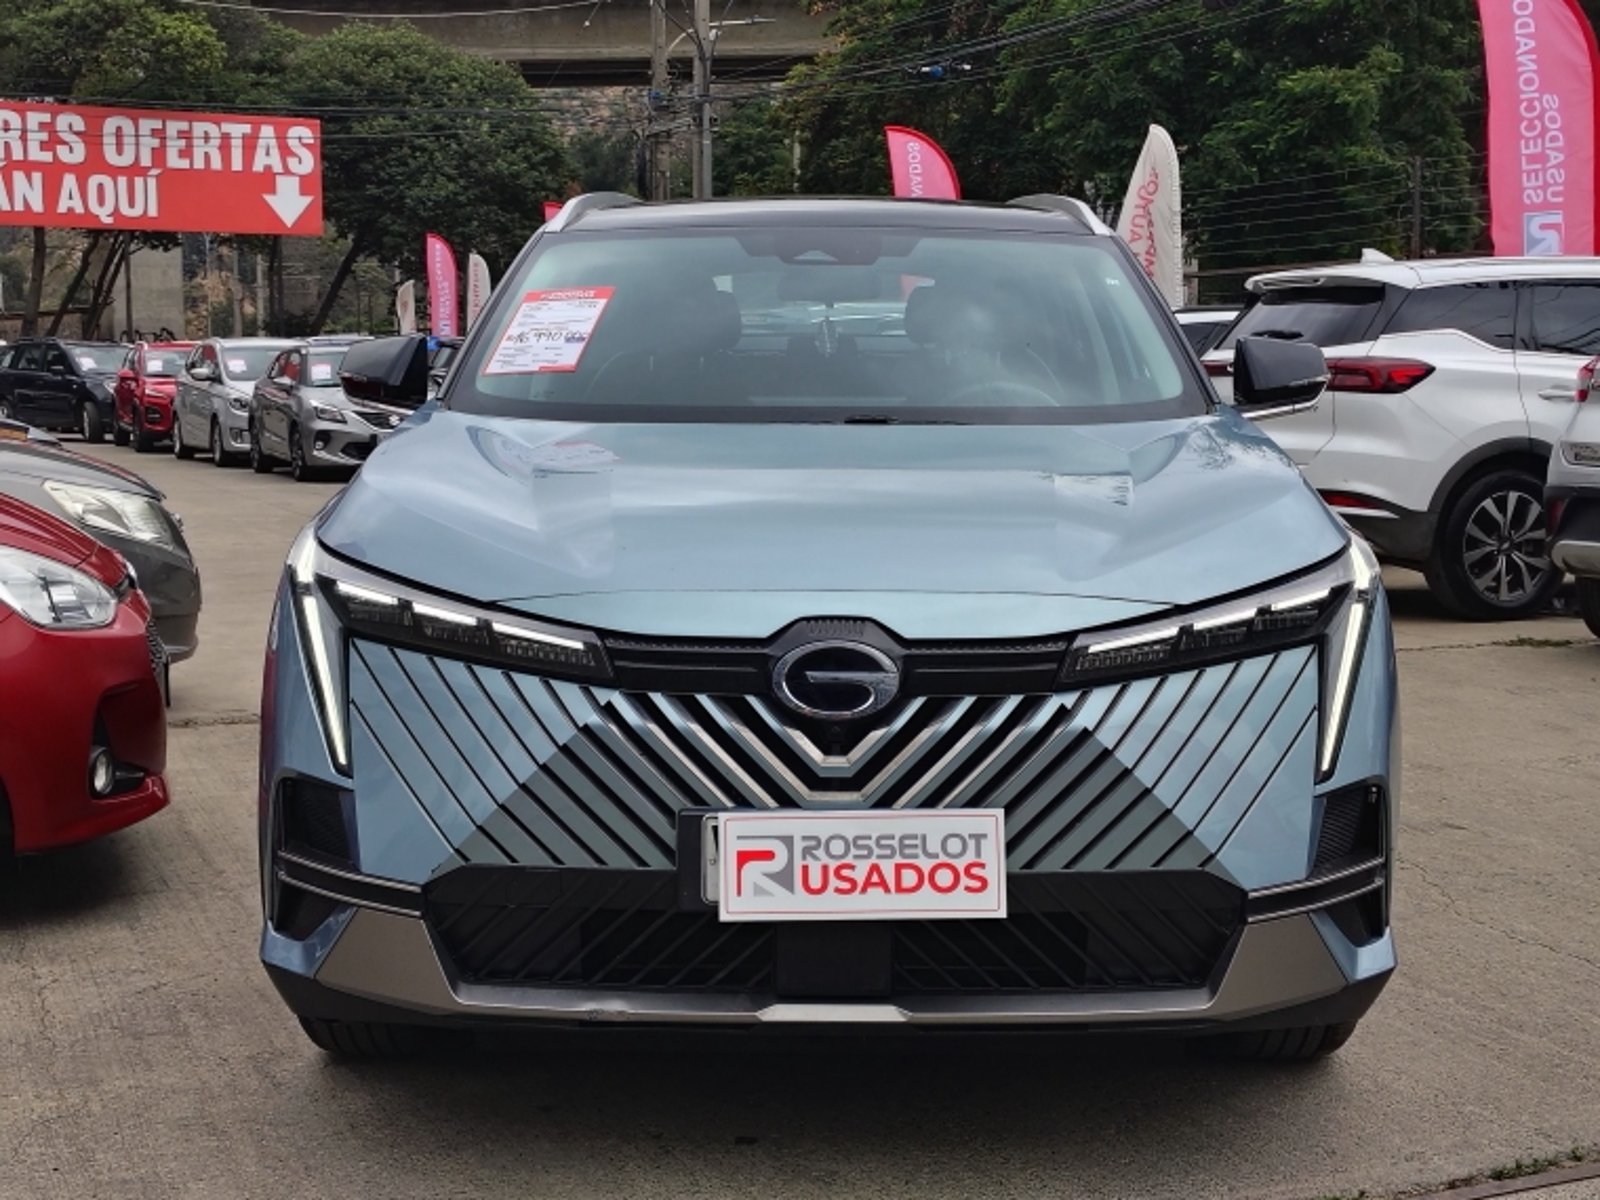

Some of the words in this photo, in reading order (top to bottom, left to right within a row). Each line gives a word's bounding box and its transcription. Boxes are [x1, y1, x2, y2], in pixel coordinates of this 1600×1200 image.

[0, 108, 86, 165] RES
[102, 115, 315, 175] OFERTAS
[56, 169, 163, 224] AQUÍ
[800, 833, 988, 862] ROSSELOT
[801, 861, 989, 896] USADOS
